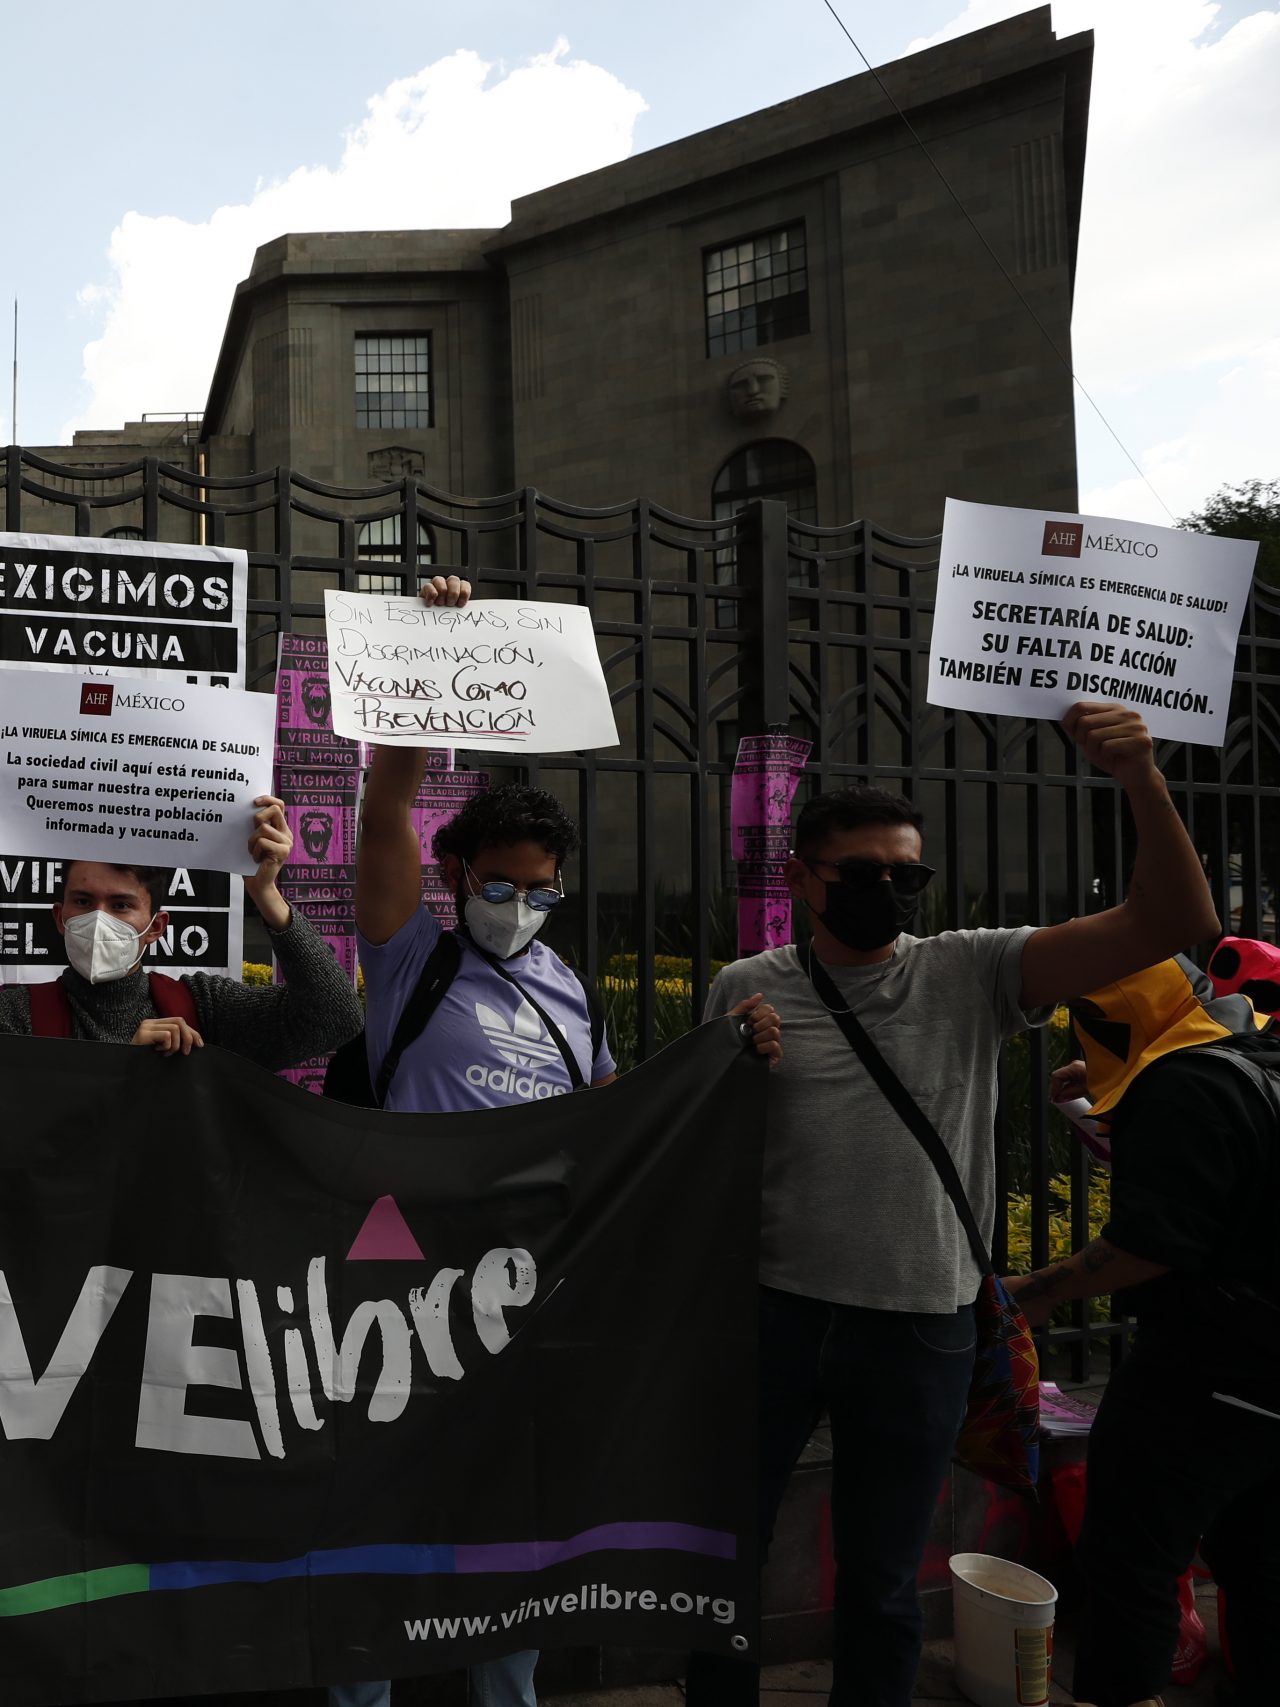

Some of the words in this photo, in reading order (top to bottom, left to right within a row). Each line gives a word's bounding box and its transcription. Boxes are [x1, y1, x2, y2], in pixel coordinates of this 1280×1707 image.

[1048, 532, 1076, 546] AHF
[1085, 534, 1158, 558] MÉXICO
[952, 564, 969, 578] ¡LA
[973, 567, 1024, 583] VIRUELA
[1030, 570, 1075, 588] SÍMICA
[1080, 577, 1095, 590] ES
[1099, 579, 1166, 602] EMERGENCIA
[1170, 592, 1183, 606] DE
[1186, 595, 1227, 613] SALUD!
[973, 600, 1099, 631] SECRETARÍA
[1107, 614, 1130, 635] DE
[1136, 620, 1193, 648] SALUD:
[25, 626, 185, 663] VACUNA
[981, 633, 1008, 652] SU
[1016, 636, 1082, 660] FALTA
[1090, 643, 1113, 664] DE
[1120, 648, 1176, 677] ACCIÓN
[939, 657, 1021, 686] TAMBIÉN
[1030, 669, 1058, 689] ES
[1066, 671, 1214, 715] DISCRIMINACIÓN.
[85, 693, 108, 705] AHF
[115, 693, 185, 712] MÉXICO
[1, 726, 18, 739] ¡LA
[22, 727, 66, 741] VIRUELA
[71, 729, 107, 743] SÍMICA
[111, 733, 125, 745] ES
[128, 734, 198, 750] EMERGENCIA
[202, 740, 217, 752] DE
[220, 742, 260, 757] SALUD!
[7, 751, 22, 765] La
[26, 753, 86, 770] sociedad
[90, 757, 118, 772] civil
[122, 762, 152, 777] aquí
[157, 763, 187, 777] está
[191, 765, 250, 786] reunida,
[310, 752, 354, 764] MONO
[17, 775, 48, 790] para
[52, 780, 94, 793] sumar
[98, 782, 150, 796] nuestra
[154, 785, 235, 803] experiencia
[280, 775, 356, 788] EXIGIMOS
[26, 796, 94, 813] Queremos
[98, 802, 150, 817] nuestra
[155, 803, 223, 823] población
[293, 795, 343, 804] VACUNA
[46, 817, 114, 836] informada
[118, 826, 126, 839] y
[130, 826, 199, 842] vacunada.
[287, 868, 348, 880] VIRUELA
[308, 888, 353, 900] MONO
[466, 1064, 567, 1099] adidas
[404, 1583, 736, 1641] www.vihvelibre.org
